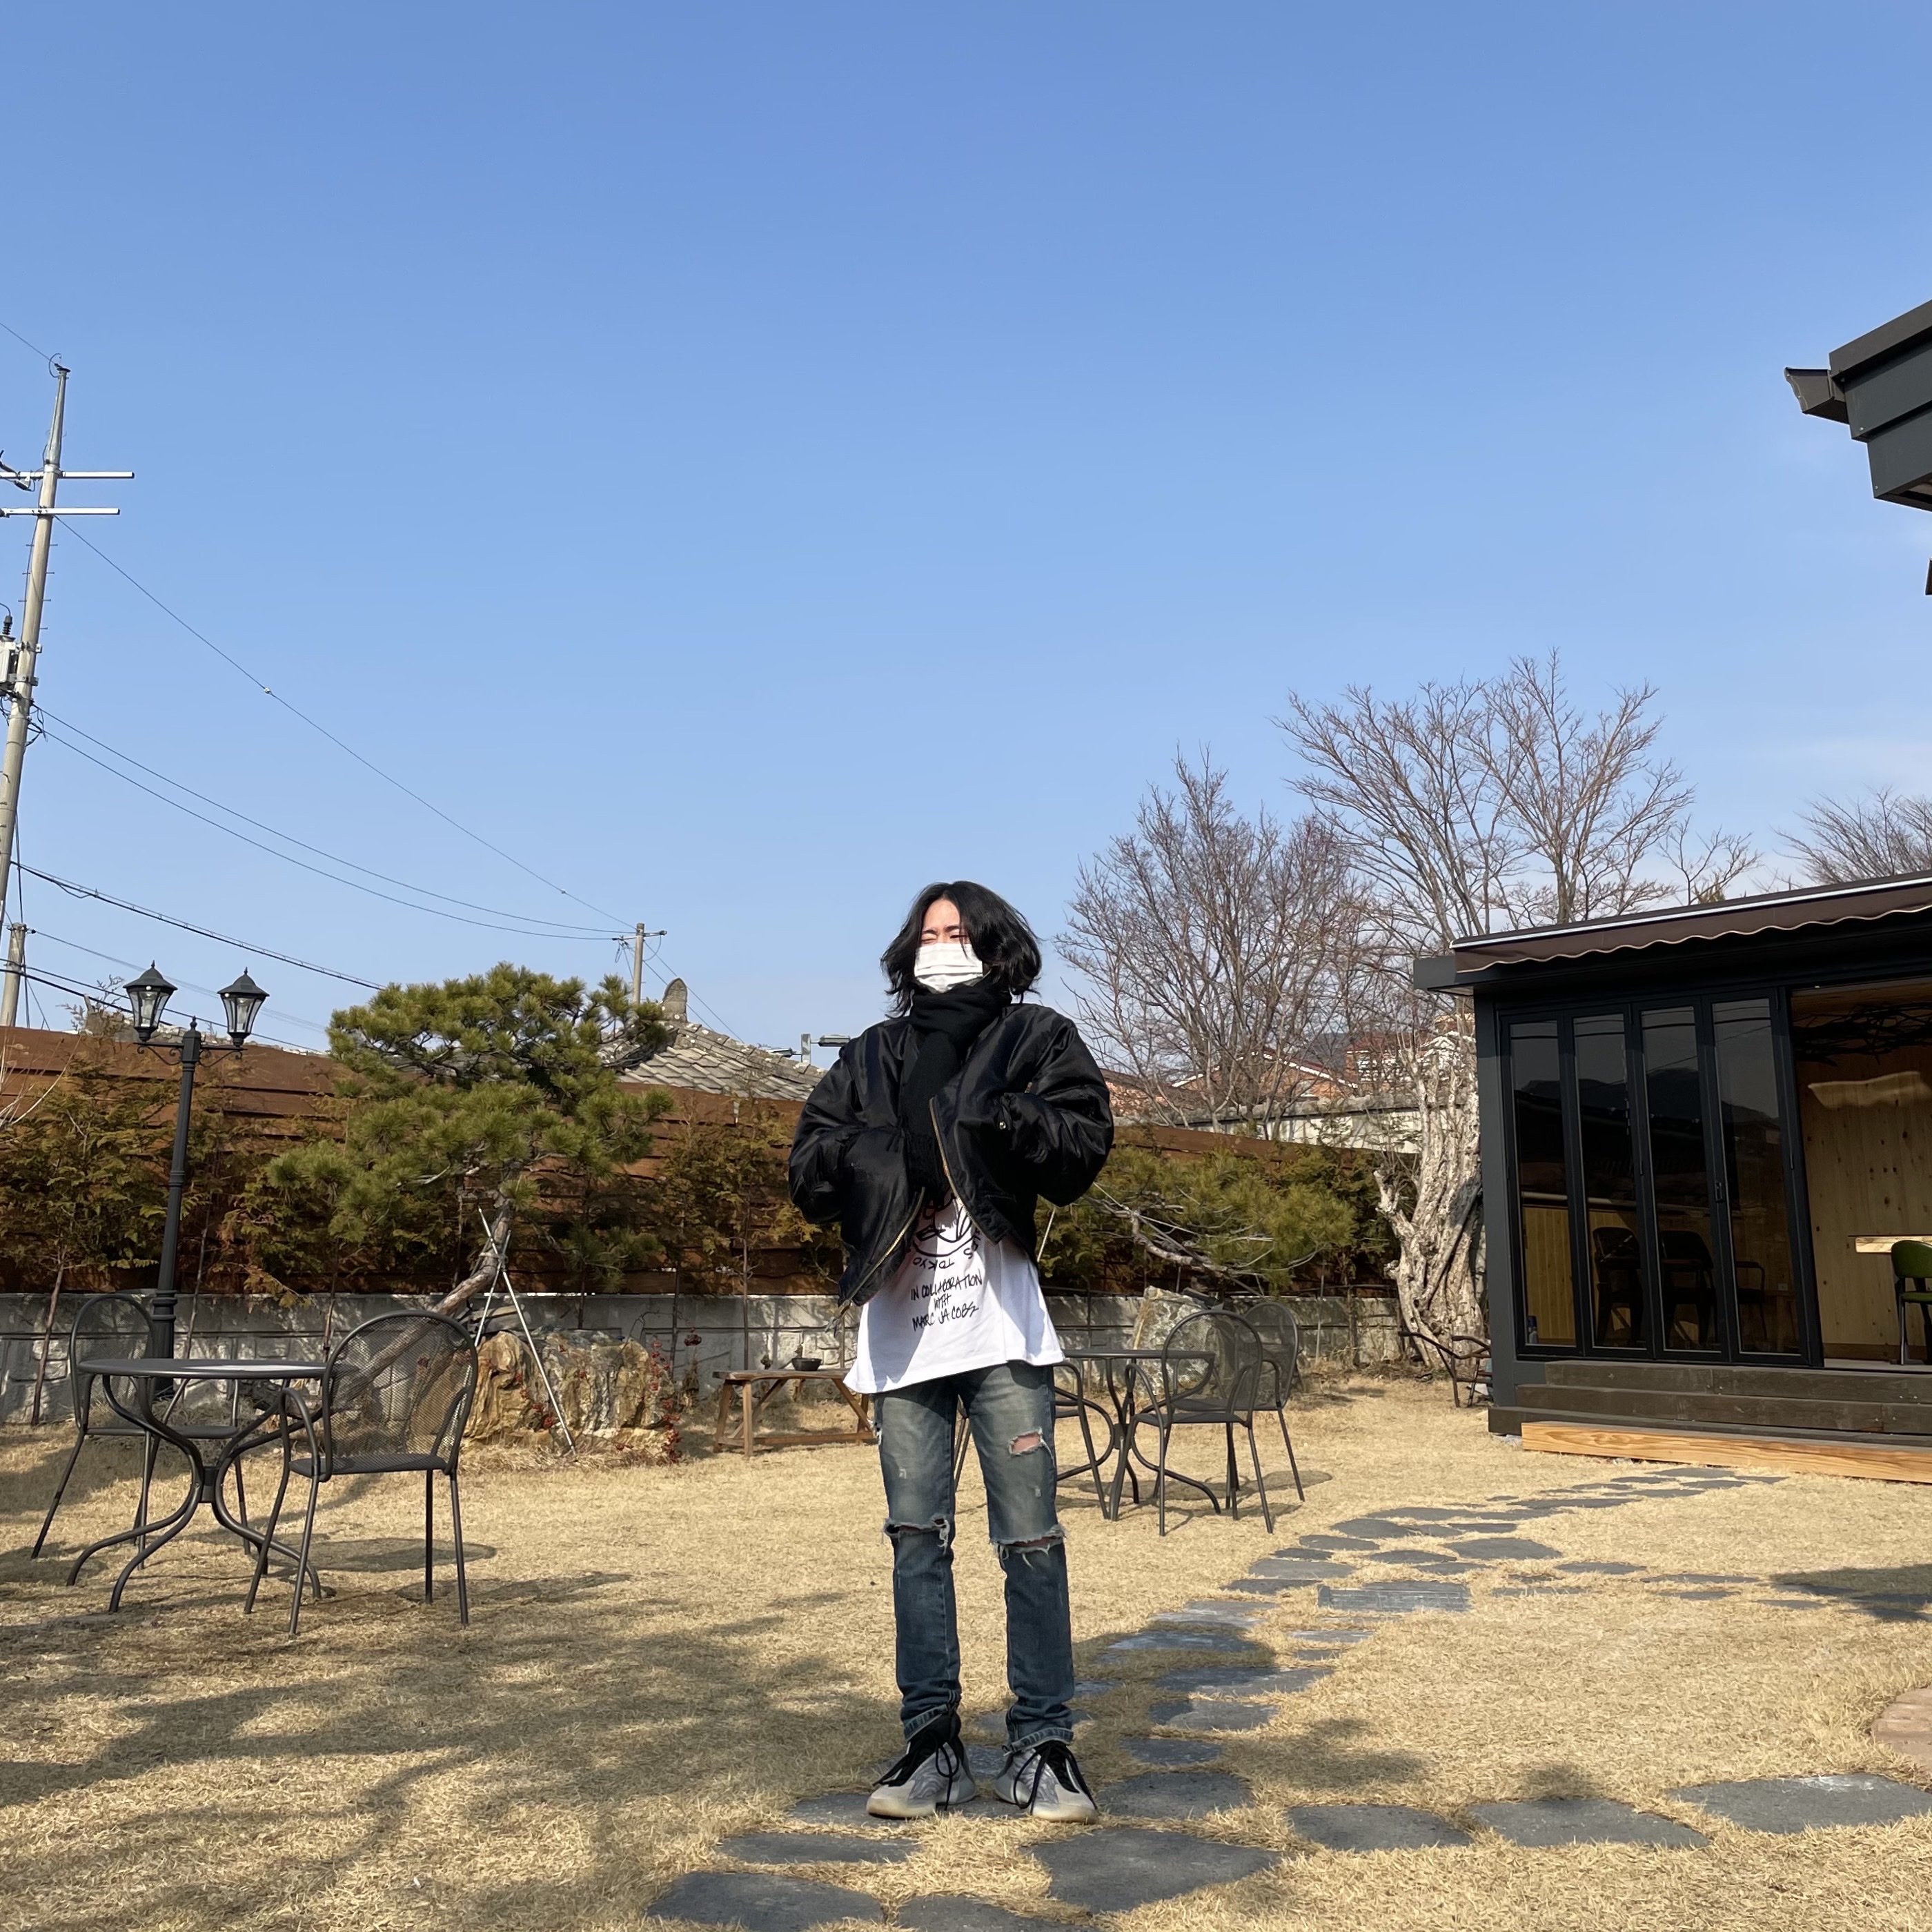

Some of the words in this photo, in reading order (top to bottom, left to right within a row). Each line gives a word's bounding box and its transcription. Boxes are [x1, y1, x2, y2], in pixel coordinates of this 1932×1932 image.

[913, 1257, 955, 1271] TOKYO
[911, 1285, 919, 1301] IN
[934, 1293, 952, 1311] WITH
[912, 1312, 936, 1332] MARC
[938, 1301, 979, 1324] JACOBS
